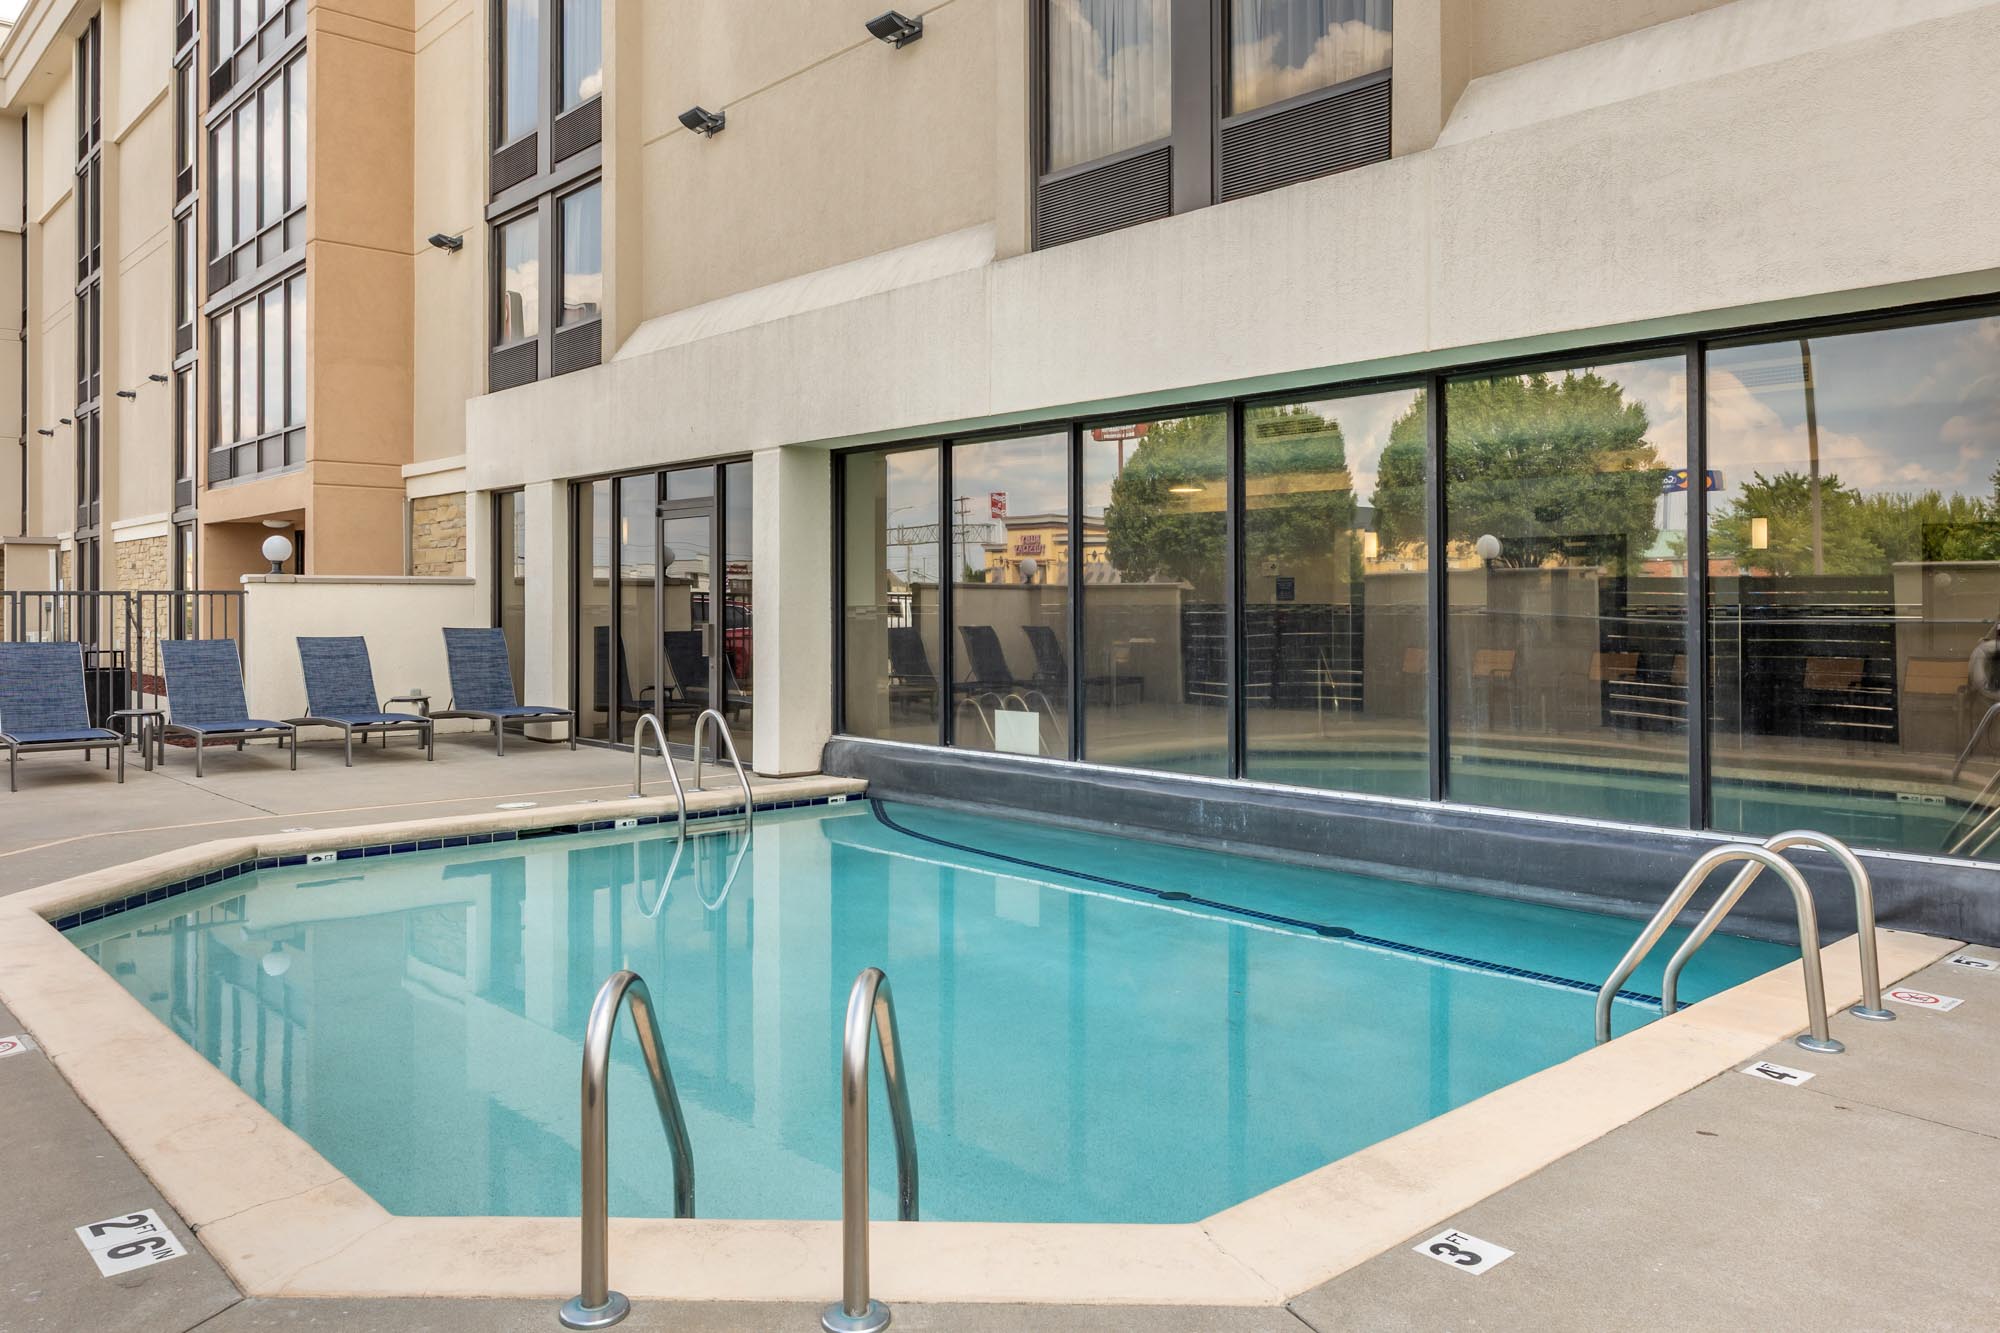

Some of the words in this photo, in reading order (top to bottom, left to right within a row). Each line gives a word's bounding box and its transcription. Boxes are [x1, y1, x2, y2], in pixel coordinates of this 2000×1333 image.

[1755, 1067, 1798, 1080] 4
[88, 1214, 149, 1238] 2
[133, 1223, 157, 1235] FT
[107, 1236, 166, 1259] 6
[151, 1247, 176, 1260] IN
[1444, 1232, 1468, 1246] FT
[1429, 1242, 1482, 1266] 3
